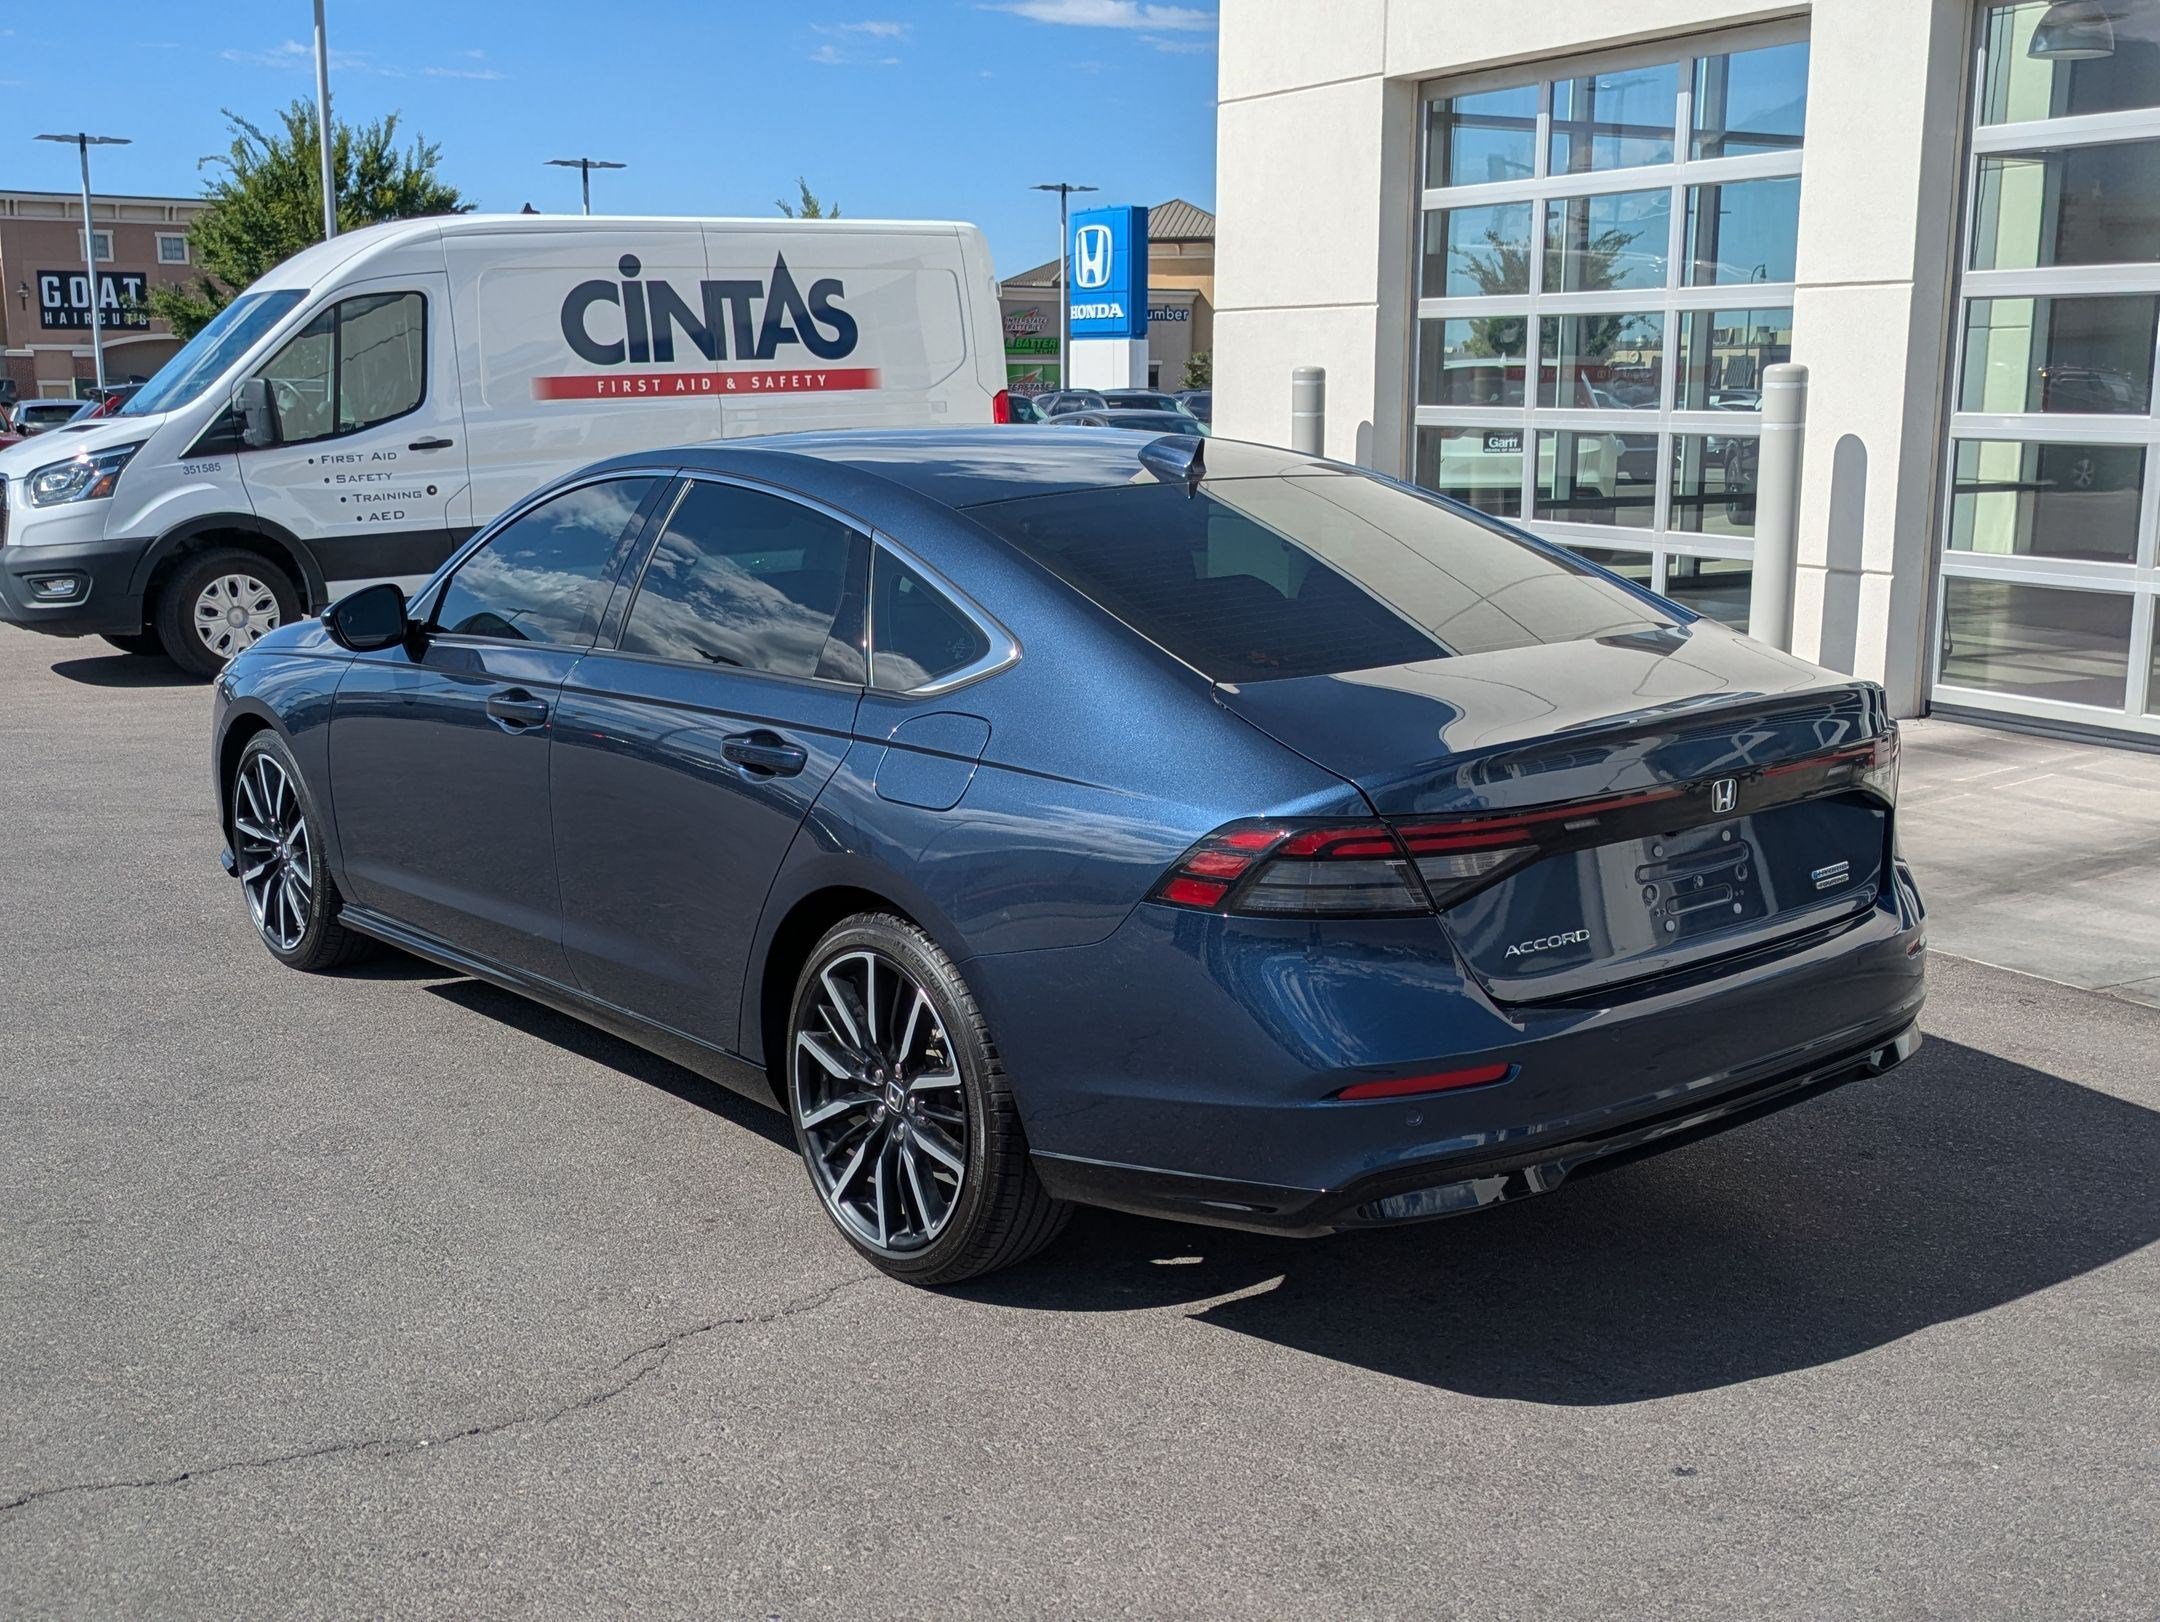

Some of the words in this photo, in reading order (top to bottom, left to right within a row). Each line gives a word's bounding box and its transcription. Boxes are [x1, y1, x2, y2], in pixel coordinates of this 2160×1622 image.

[41, 276, 141, 309] G.OA.T
[1070, 303, 1124, 319] HONDA
[1147, 305, 1188, 320] umber
[1015, 338, 1057, 348] BATTER
[598, 379, 661, 393] FIRST
[676, 377, 711, 391] AID
[726, 378, 736, 389] &
[752, 374, 827, 389] SAFETY
[321, 454, 364, 464] FIRST
[371, 452, 397, 462] AID
[183, 462, 222, 475] 351585
[336, 472, 393, 483] SAFETY
[352, 490, 422, 503] TRAINING
[368, 510, 405, 522] AED
[1504, 929, 1590, 958] ACCORD
